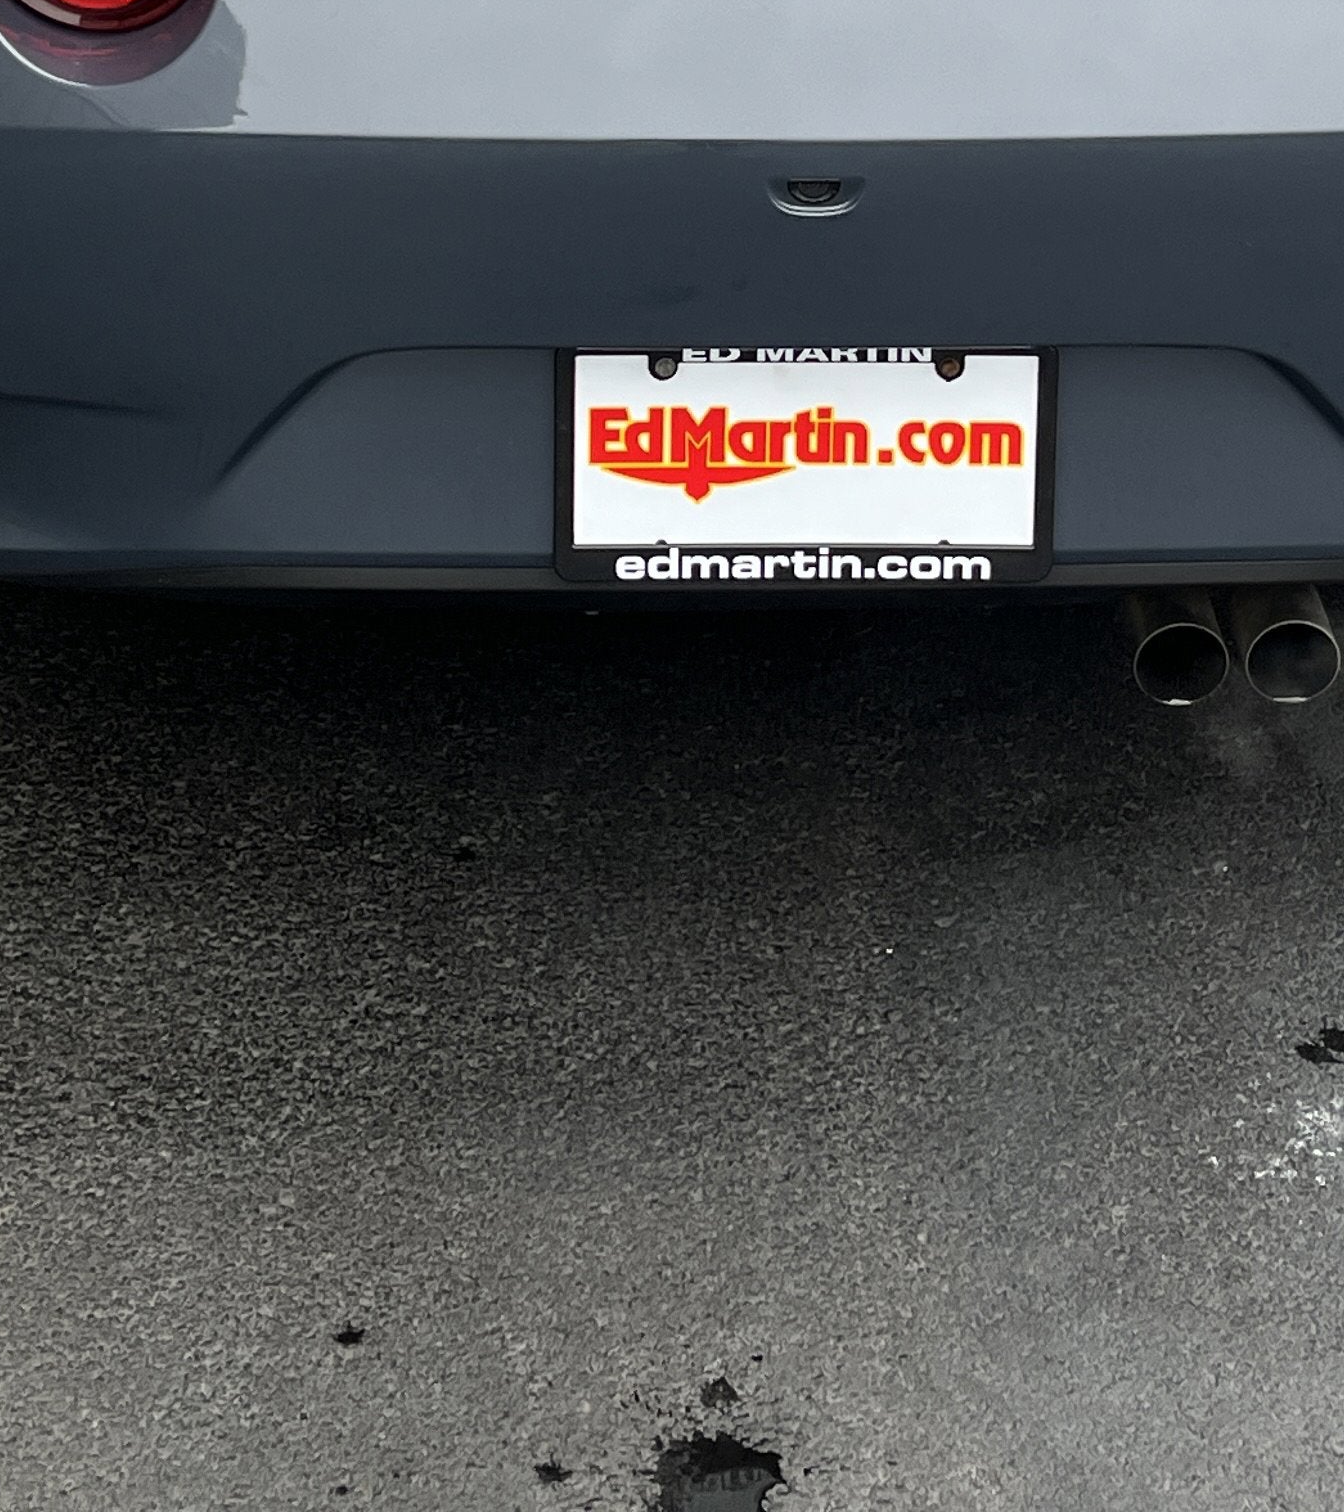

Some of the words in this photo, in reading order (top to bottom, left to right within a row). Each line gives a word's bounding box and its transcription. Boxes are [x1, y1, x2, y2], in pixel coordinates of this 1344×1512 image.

[682, 347, 742, 362] ED
[757, 347, 933, 362] MARTIN
[587, 405, 1025, 503] EdMartin.com
[615, 547, 992, 580] edmartin.com
